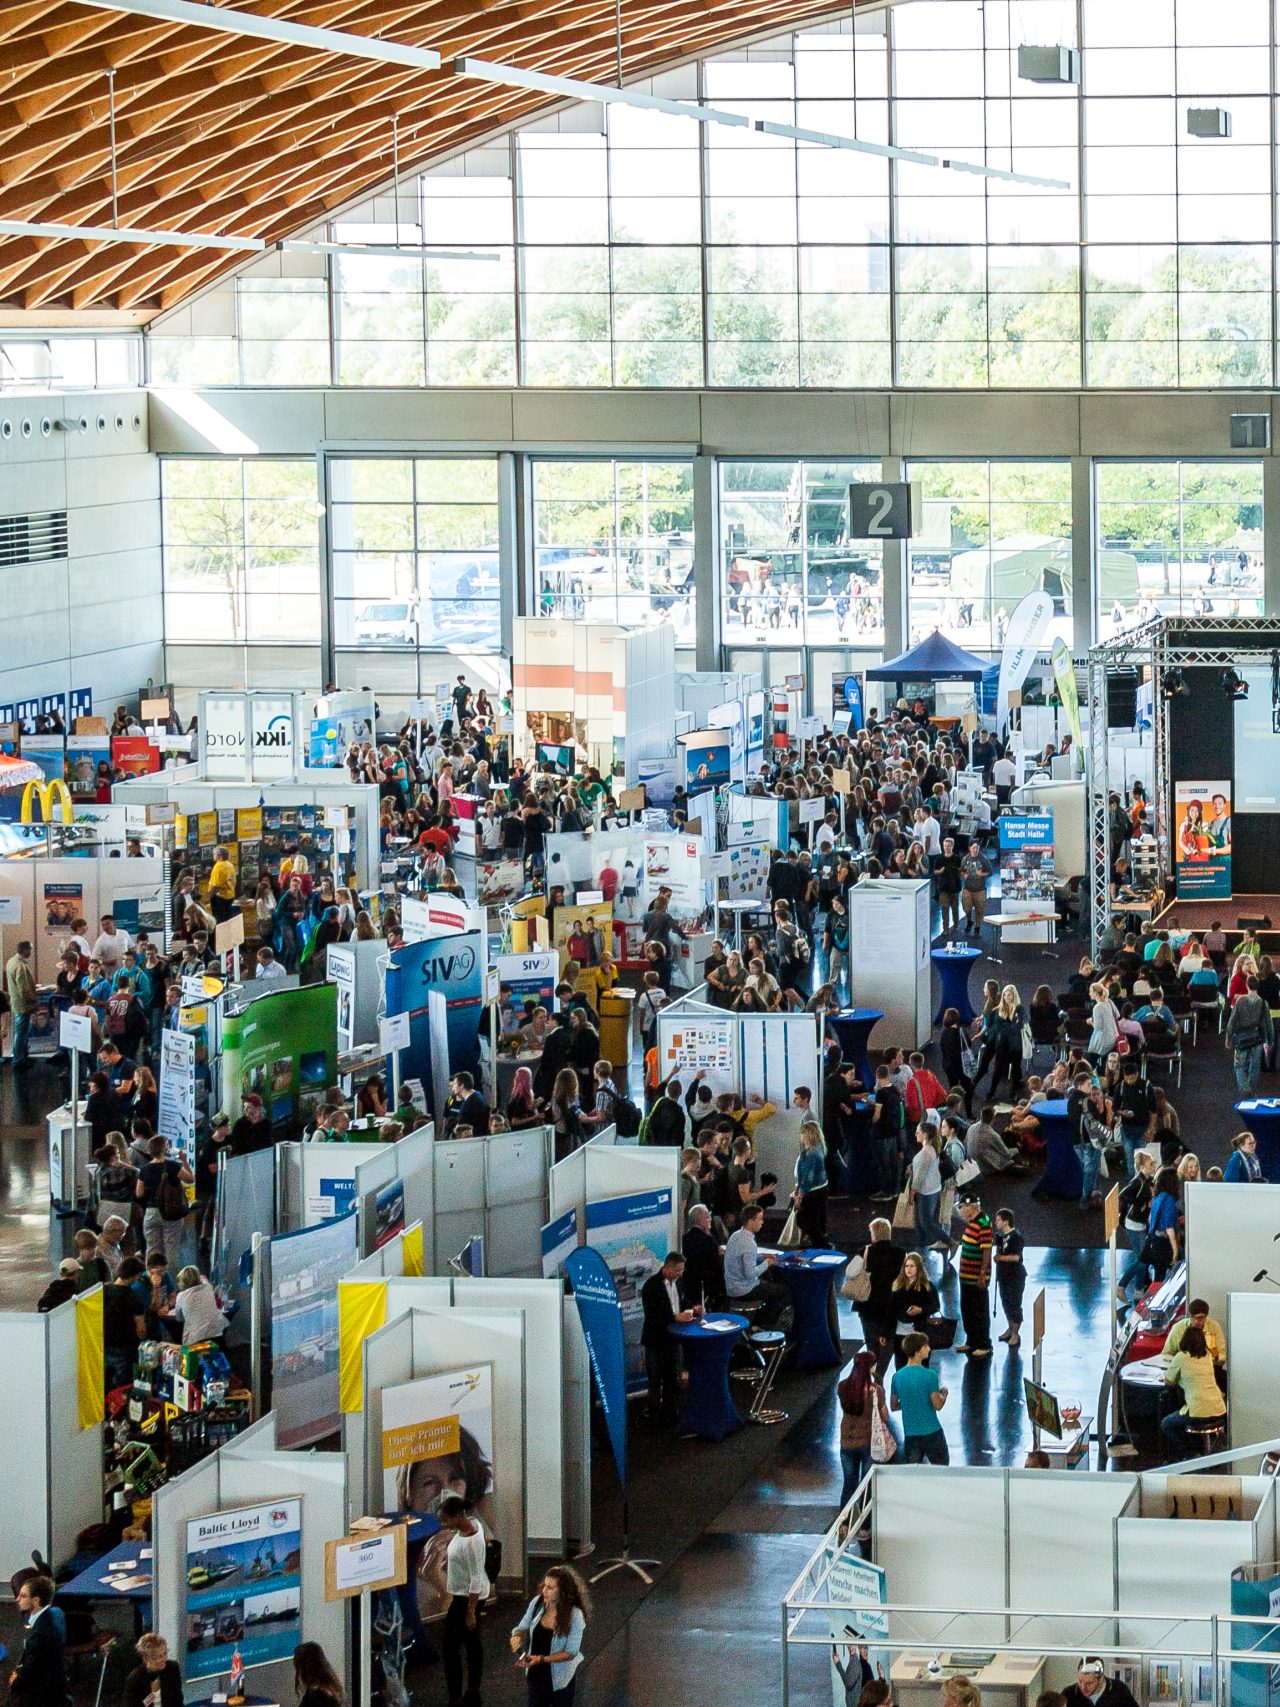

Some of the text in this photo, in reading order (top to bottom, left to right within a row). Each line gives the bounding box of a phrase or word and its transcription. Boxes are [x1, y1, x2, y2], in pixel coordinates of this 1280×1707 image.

[1240, 418, 1254, 445] 1
[867, 488, 894, 536] 2
[1011, 604, 1045, 671] ILIM TIMBER
[1004, 821, 1050, 830] Hanse Messe
[1007, 830, 1045, 839] Stadt Halle
[421, 952, 470, 986] SIV AG
[522, 960, 540, 971] SIV
[388, 1433, 415, 1446] Diese
[410, 1443, 425, 1455] ich
[199, 1515, 260, 1537] Baltic Lloyd
[358, 1552, 374, 1563] 360
[829, 1574, 879, 1600] Manche machen
